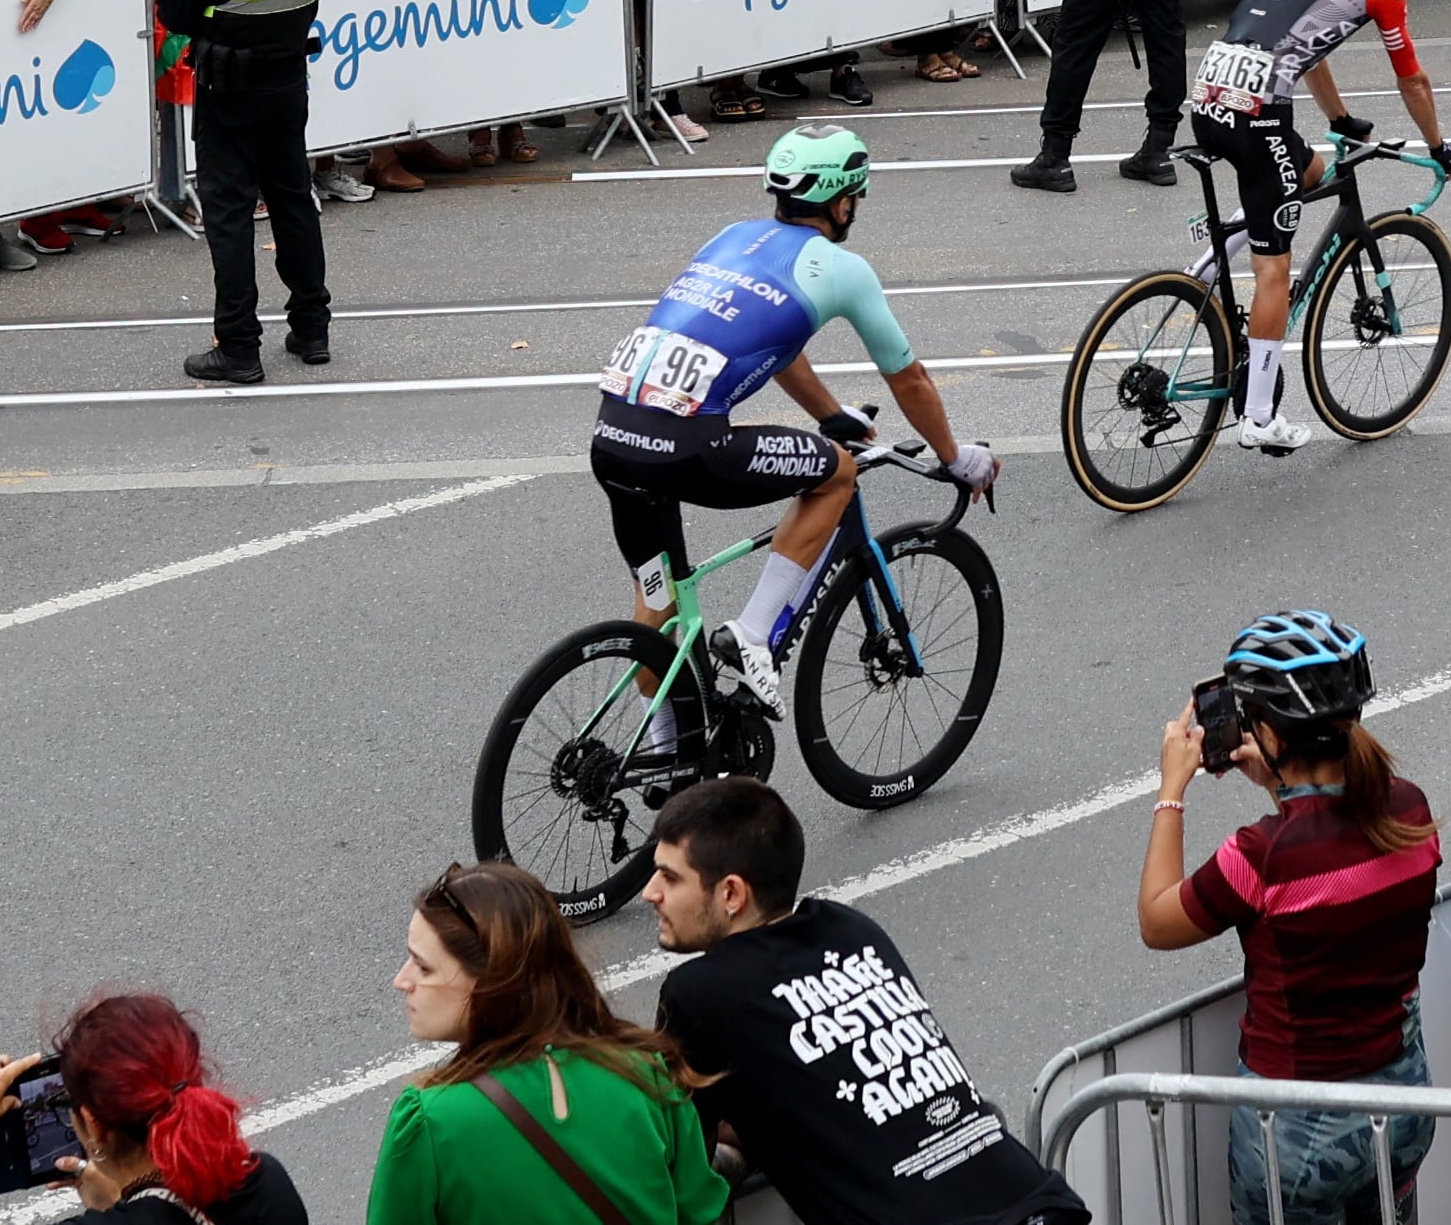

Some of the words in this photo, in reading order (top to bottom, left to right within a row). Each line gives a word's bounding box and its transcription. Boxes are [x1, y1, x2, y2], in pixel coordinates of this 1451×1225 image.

[1197, 50, 1225, 84] 63
[1275, 20, 1358, 86] ARKEA
[1221, 54, 1269, 94] 163
[817, 176, 845, 190] VAN
[1264, 135, 1298, 196] ARKEA
[675, 276, 713, 297] AG2R
[710, 284, 735, 304] LA
[691, 263, 788, 307] DECATHLON
[666, 288, 740, 322] MONDIALE
[661, 345, 708, 393] 96
[730, 355, 778, 401] DECATHLON
[602, 426, 675, 454] DECATHLON
[755, 436, 795, 454] AG2R
[795, 436, 818, 455] LA
[746, 456, 828, 476] MONDIALE
[643, 570, 663, 597] 96
[557, 899, 598, 917] SWISSSID
[771, 945, 895, 1019] MAKE
[788, 975, 931, 1066] CASTILLA
[851, 1015, 946, 1080] COOL
